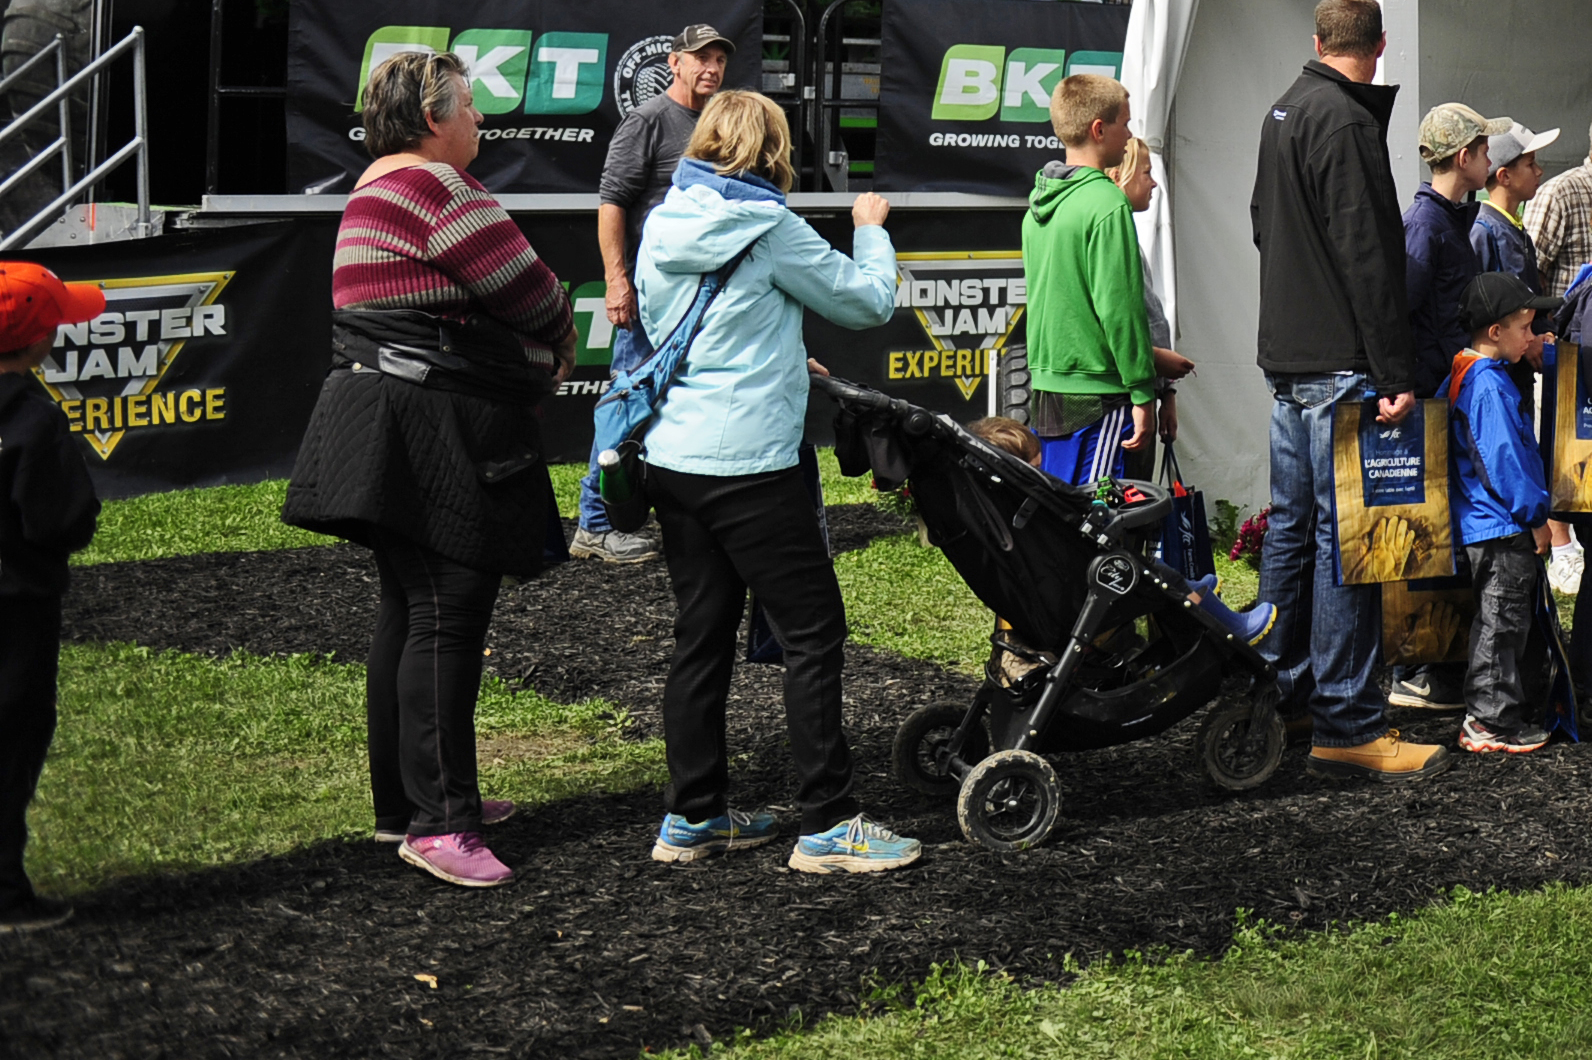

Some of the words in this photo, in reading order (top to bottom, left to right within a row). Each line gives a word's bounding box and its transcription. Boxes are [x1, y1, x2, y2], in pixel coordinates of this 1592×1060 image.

[622, 41, 673, 79] OFF-HIG
[929, 132, 1021, 148] GROWING
[894, 277, 1027, 308] MONSTE
[53, 304, 228, 348] NSTER
[931, 307, 1007, 336] JAM
[44, 344, 158, 383] JAM
[888, 347, 990, 380] EXPERI
[61, 387, 227, 432] ERIENCE
[1364, 456, 1421, 469] L'AGRICULTURE
[1368, 467, 1418, 479] CANADIENNE
